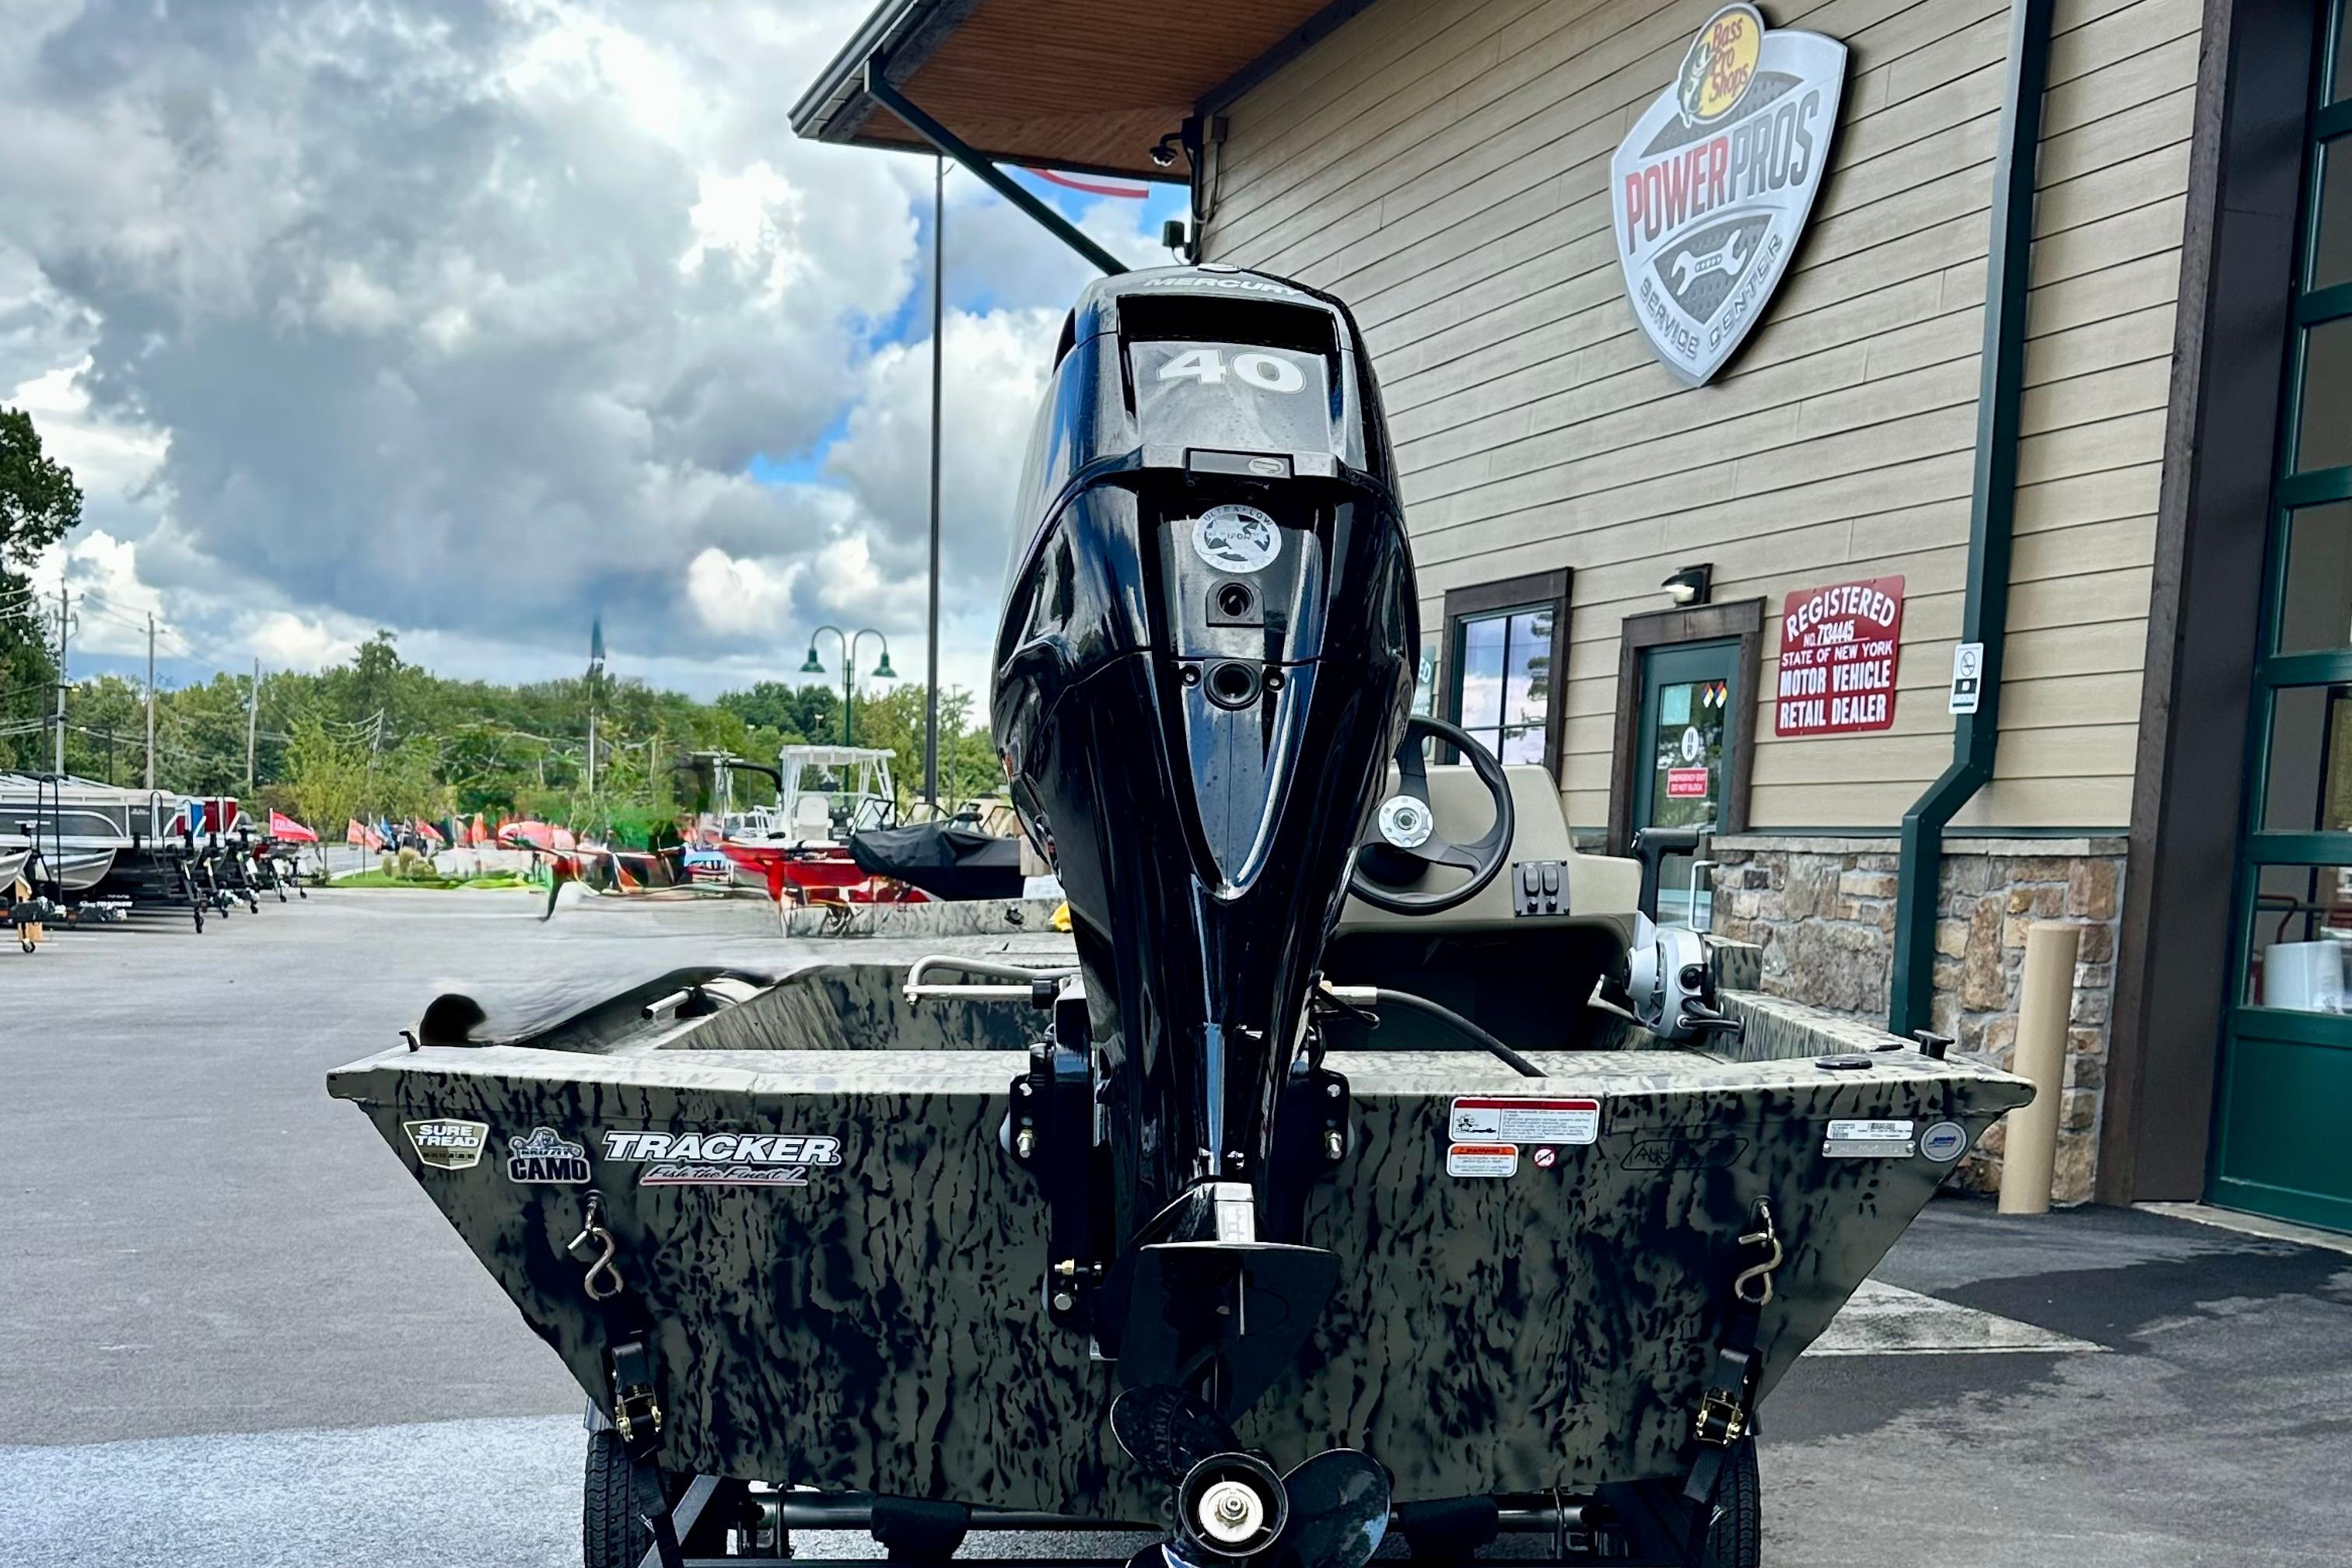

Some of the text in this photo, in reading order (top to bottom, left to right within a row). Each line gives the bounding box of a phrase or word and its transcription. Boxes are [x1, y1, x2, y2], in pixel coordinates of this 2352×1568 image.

[1713, 17, 1743, 47] Bass
[1713, 47, 1734, 75] Pro
[1709, 63, 1748, 102] Shops
[1143, 278, 1305, 296] MERCURY
[1640, 233, 1783, 359] SERVICE CENTER
[1157, 348, 1307, 394] 40
[1787, 586, 1895, 642] REGISTERED
[1781, 640, 1893, 667] STATE OF NEW YORK
[1780, 660, 1892, 697] MOTOR VEHICLE
[1780, 694, 1886, 729] RETAIL DEALER
[415, 1136, 480, 1147] TREAD
[419, 1125, 473, 1136] SURE
[606, 1134, 838, 1162] TRACKER
[510, 1157, 588, 1181] CAMO
[648, 1167, 688, 1178] Fish
[692, 1167, 720, 1178] the
